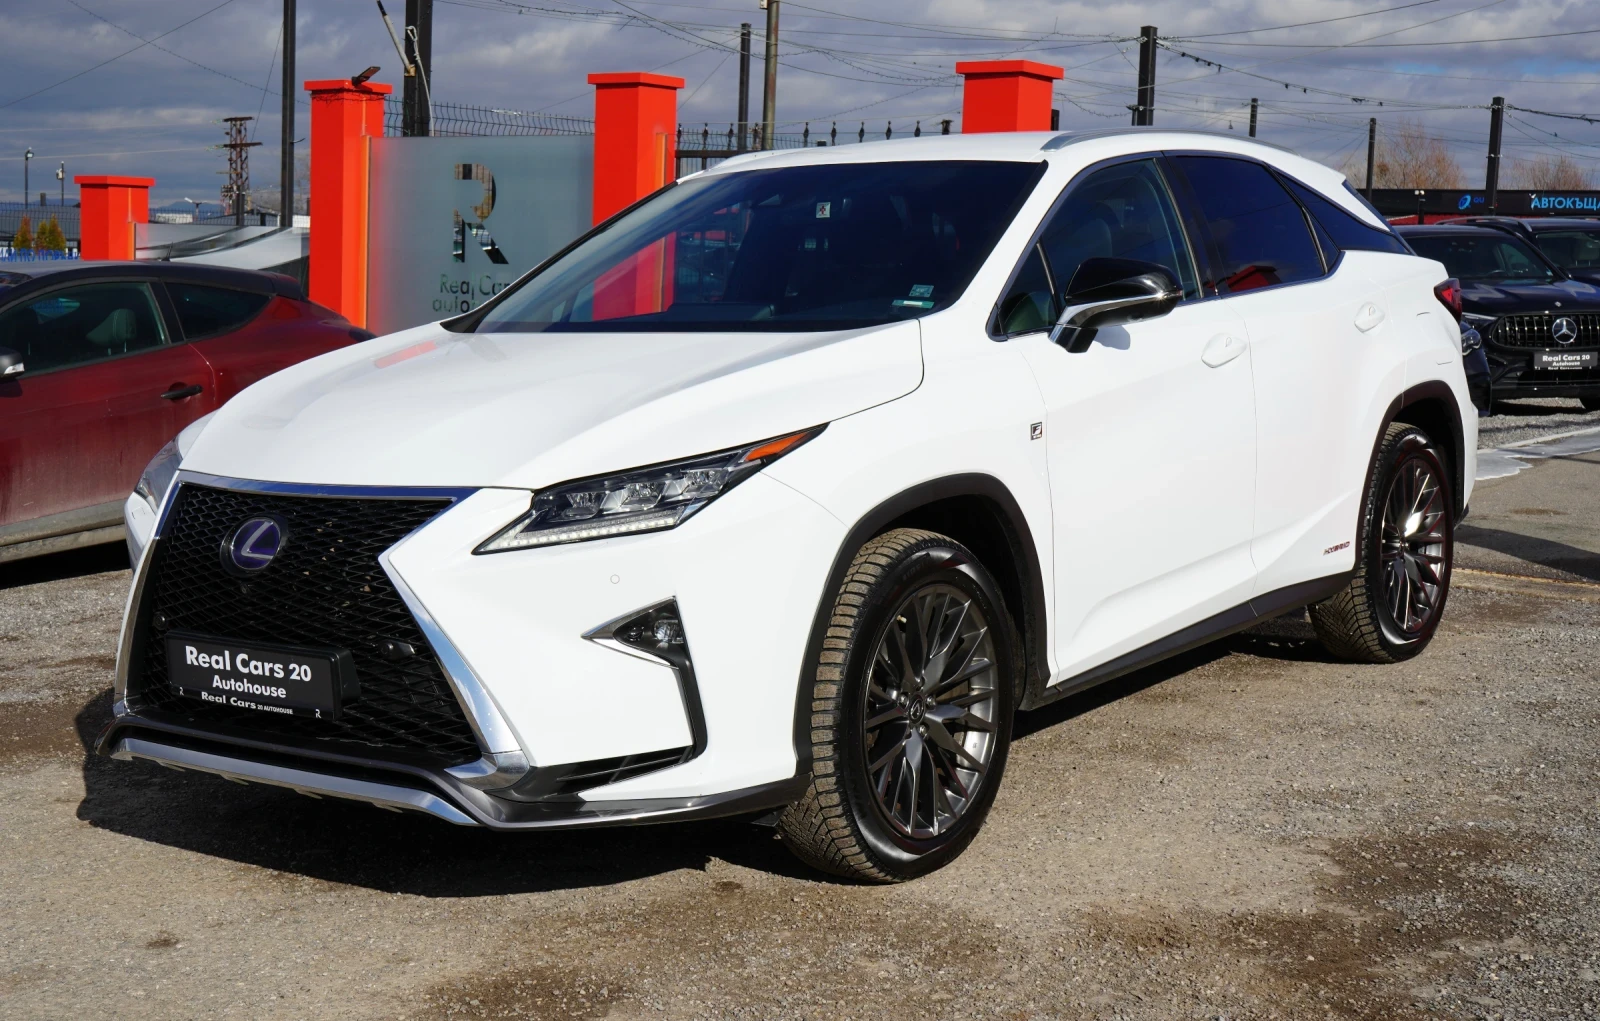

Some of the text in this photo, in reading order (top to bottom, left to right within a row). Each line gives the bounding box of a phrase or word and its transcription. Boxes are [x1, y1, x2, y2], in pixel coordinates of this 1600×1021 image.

[440, 272, 475, 295] Real
[185, 645, 312, 682] Real Cars 20
[212, 674, 287, 698] Autohouse
[201, 691, 226, 704] Real
[230, 697, 256, 709] Cars
[263, 706, 293, 715] AUTOHOUSE
